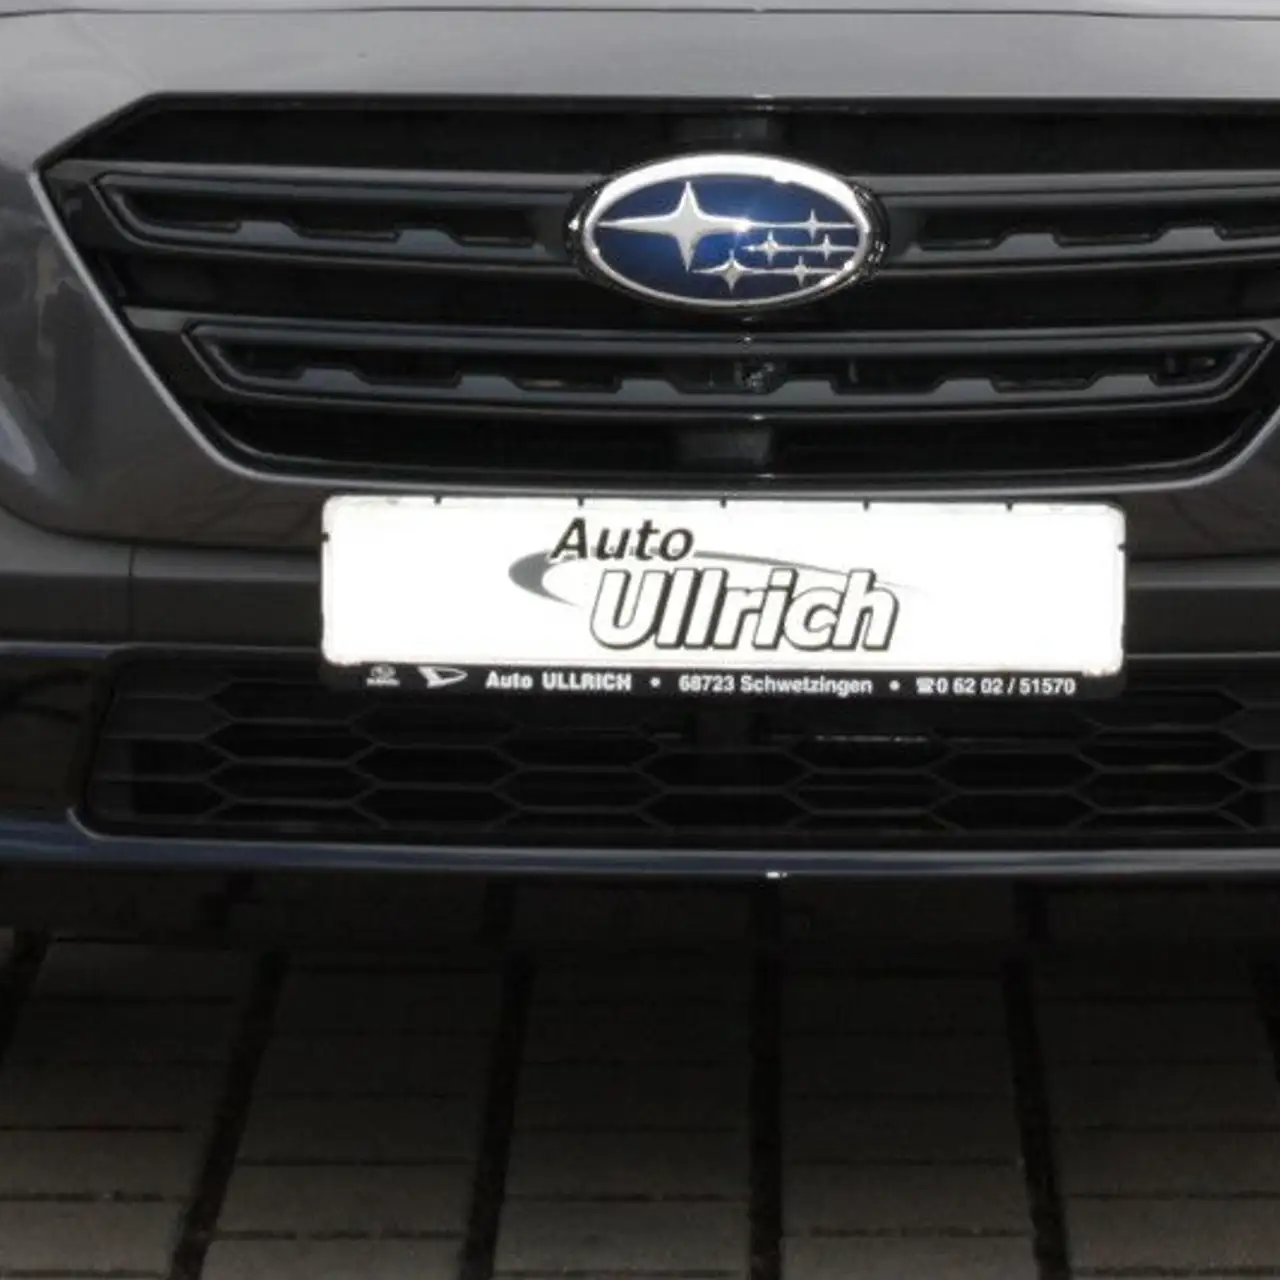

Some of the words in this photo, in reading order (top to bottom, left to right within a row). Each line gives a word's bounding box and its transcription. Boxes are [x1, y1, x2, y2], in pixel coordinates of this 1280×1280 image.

[549, 517, 694, 561] Auto
[590, 567, 900, 652] Ullrich
[485, 670, 533, 690] Auto
[541, 671, 632, 691] ULLRICH
[678, 673, 734, 693] 68723
[740, 674, 873, 697] Schwetzingen
[1019, 677, 1076, 696] 51570
